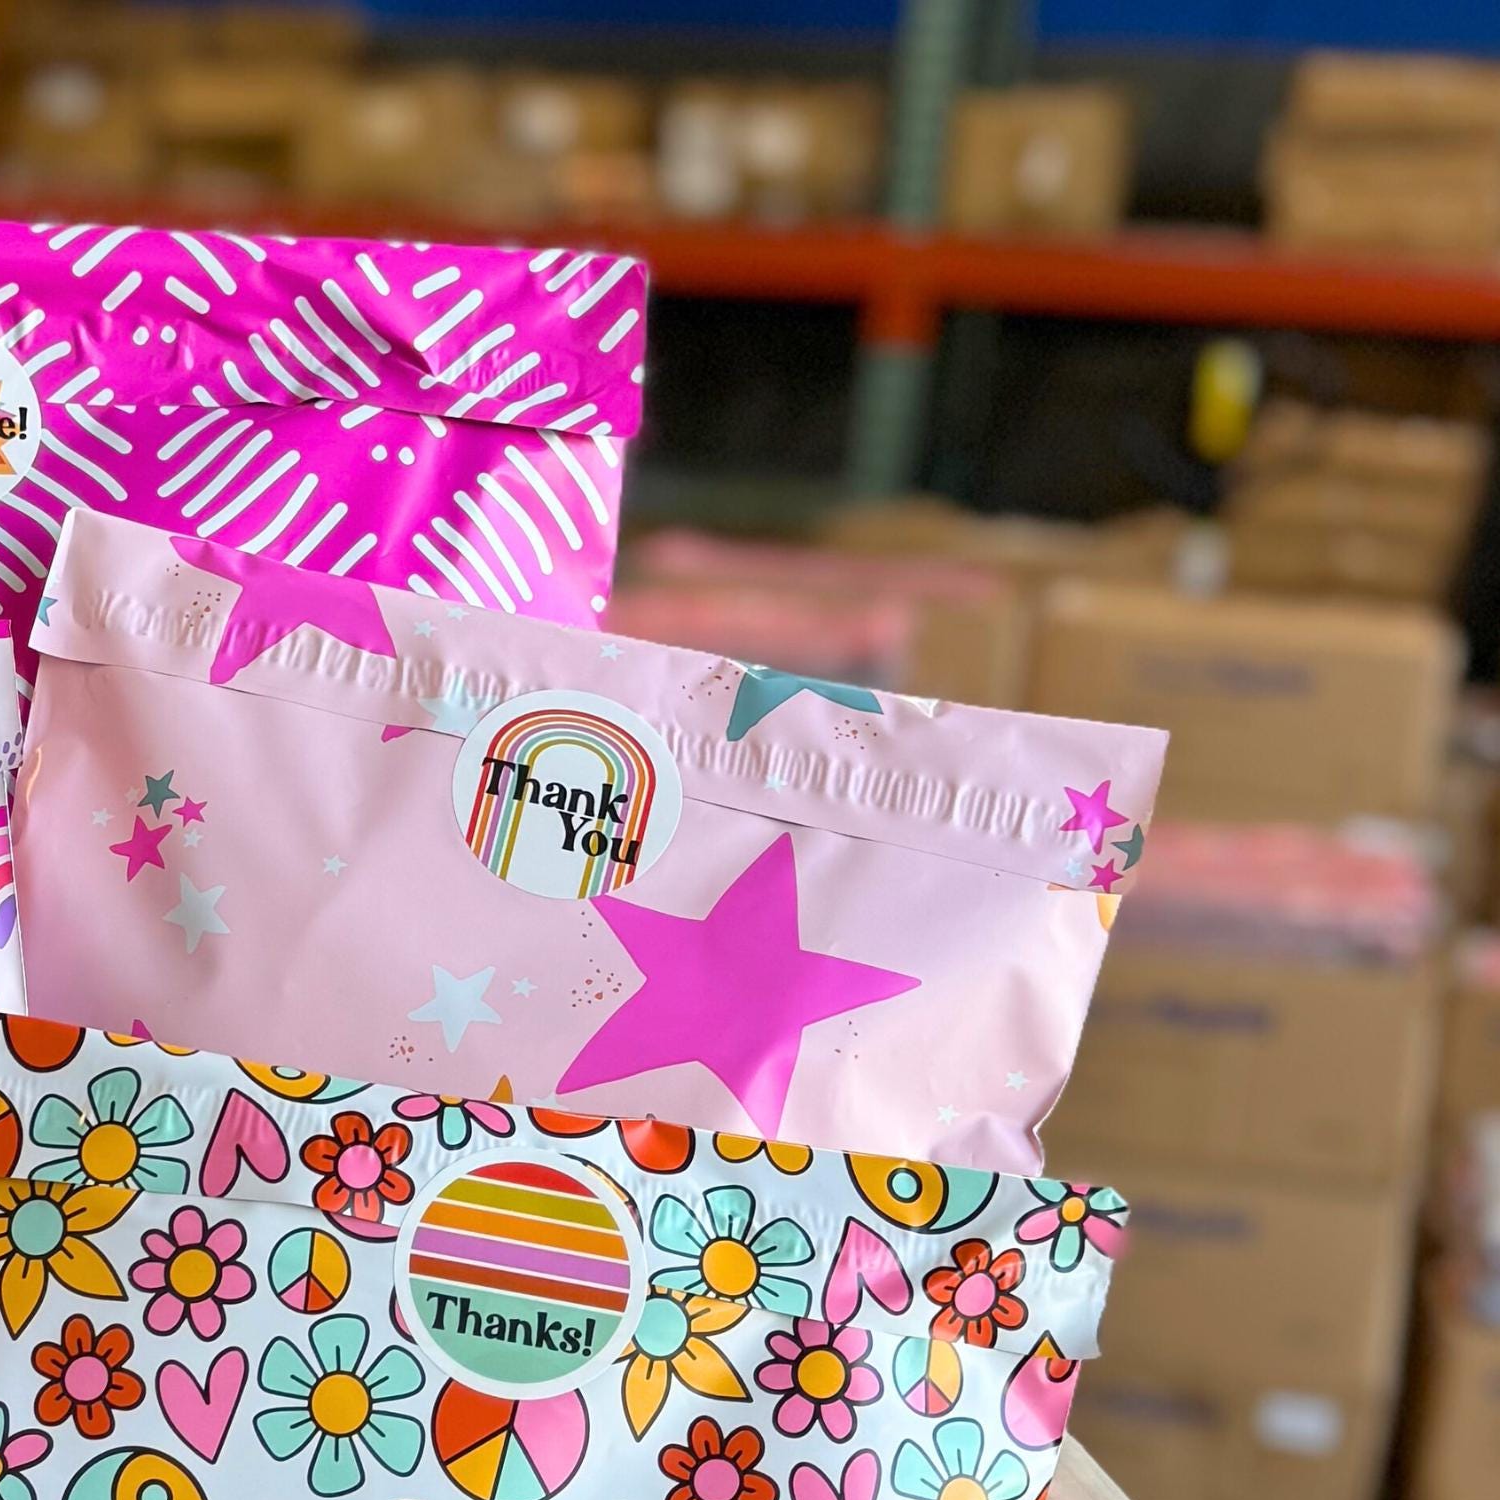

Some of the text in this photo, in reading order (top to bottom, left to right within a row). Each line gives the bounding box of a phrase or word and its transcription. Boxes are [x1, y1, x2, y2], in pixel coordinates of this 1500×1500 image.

[482, 757, 628, 824] Thank
[559, 811, 641, 866] You
[426, 1291, 596, 1357] Thanks!
